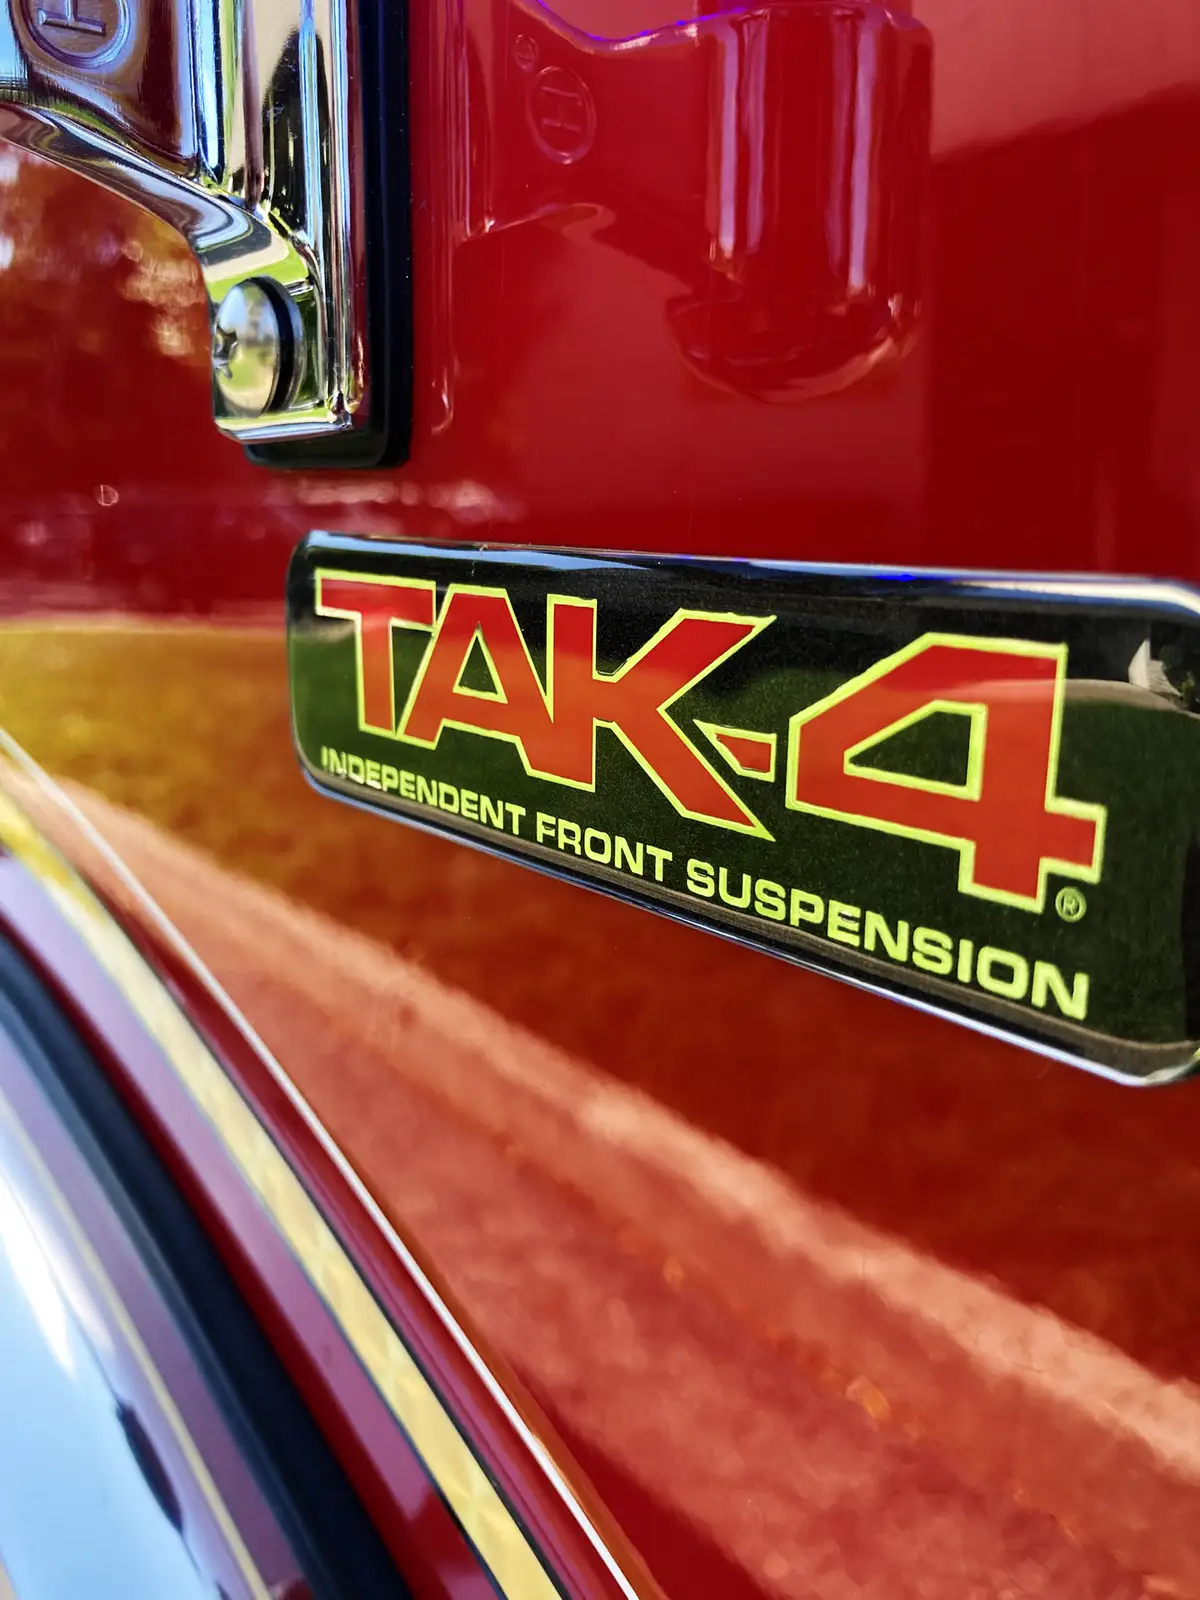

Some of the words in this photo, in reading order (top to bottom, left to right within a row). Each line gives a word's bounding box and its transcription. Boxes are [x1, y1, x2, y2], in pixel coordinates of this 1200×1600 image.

[315, 568, 1107, 914] TAK-4
[321, 746, 526, 834] INDEPENDENT
[536, 812, 672, 882] FRONT
[686, 859, 1090, 1020] SUSPENSION
